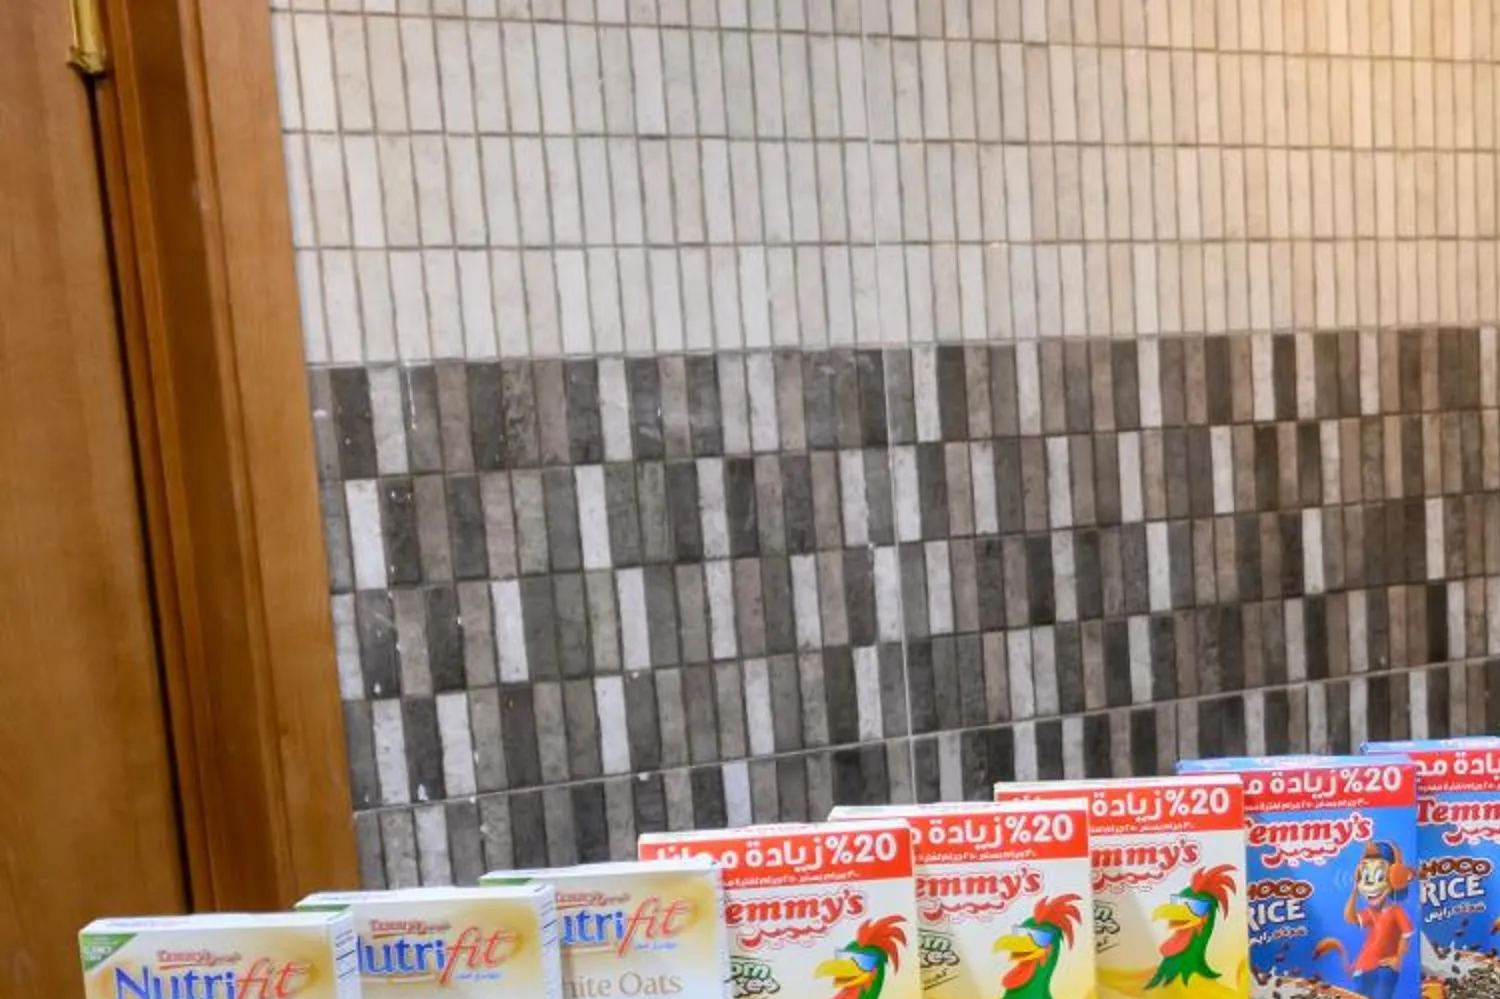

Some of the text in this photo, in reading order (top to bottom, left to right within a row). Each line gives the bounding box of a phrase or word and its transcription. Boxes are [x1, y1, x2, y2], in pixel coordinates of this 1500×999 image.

[1270, 770, 1338, 799] زيادة
[1093, 793, 1163, 822] زيادة
[929, 820, 1003, 850] زيادة
[746, 838, 825, 873] زيادة
[1091, 840, 1199, 871] mmy's
[1419, 857, 1493, 879] HOCO
[915, 866, 1042, 898] emmy's
[1248, 878, 1314, 898] OCO
[1420, 877, 1485, 906] RICE
[725, 888, 865, 925] emmy's
[562, 896, 688, 959] trifit
[562, 971, 683, 998] hite Oats
[730, 962, 770, 981] orn
